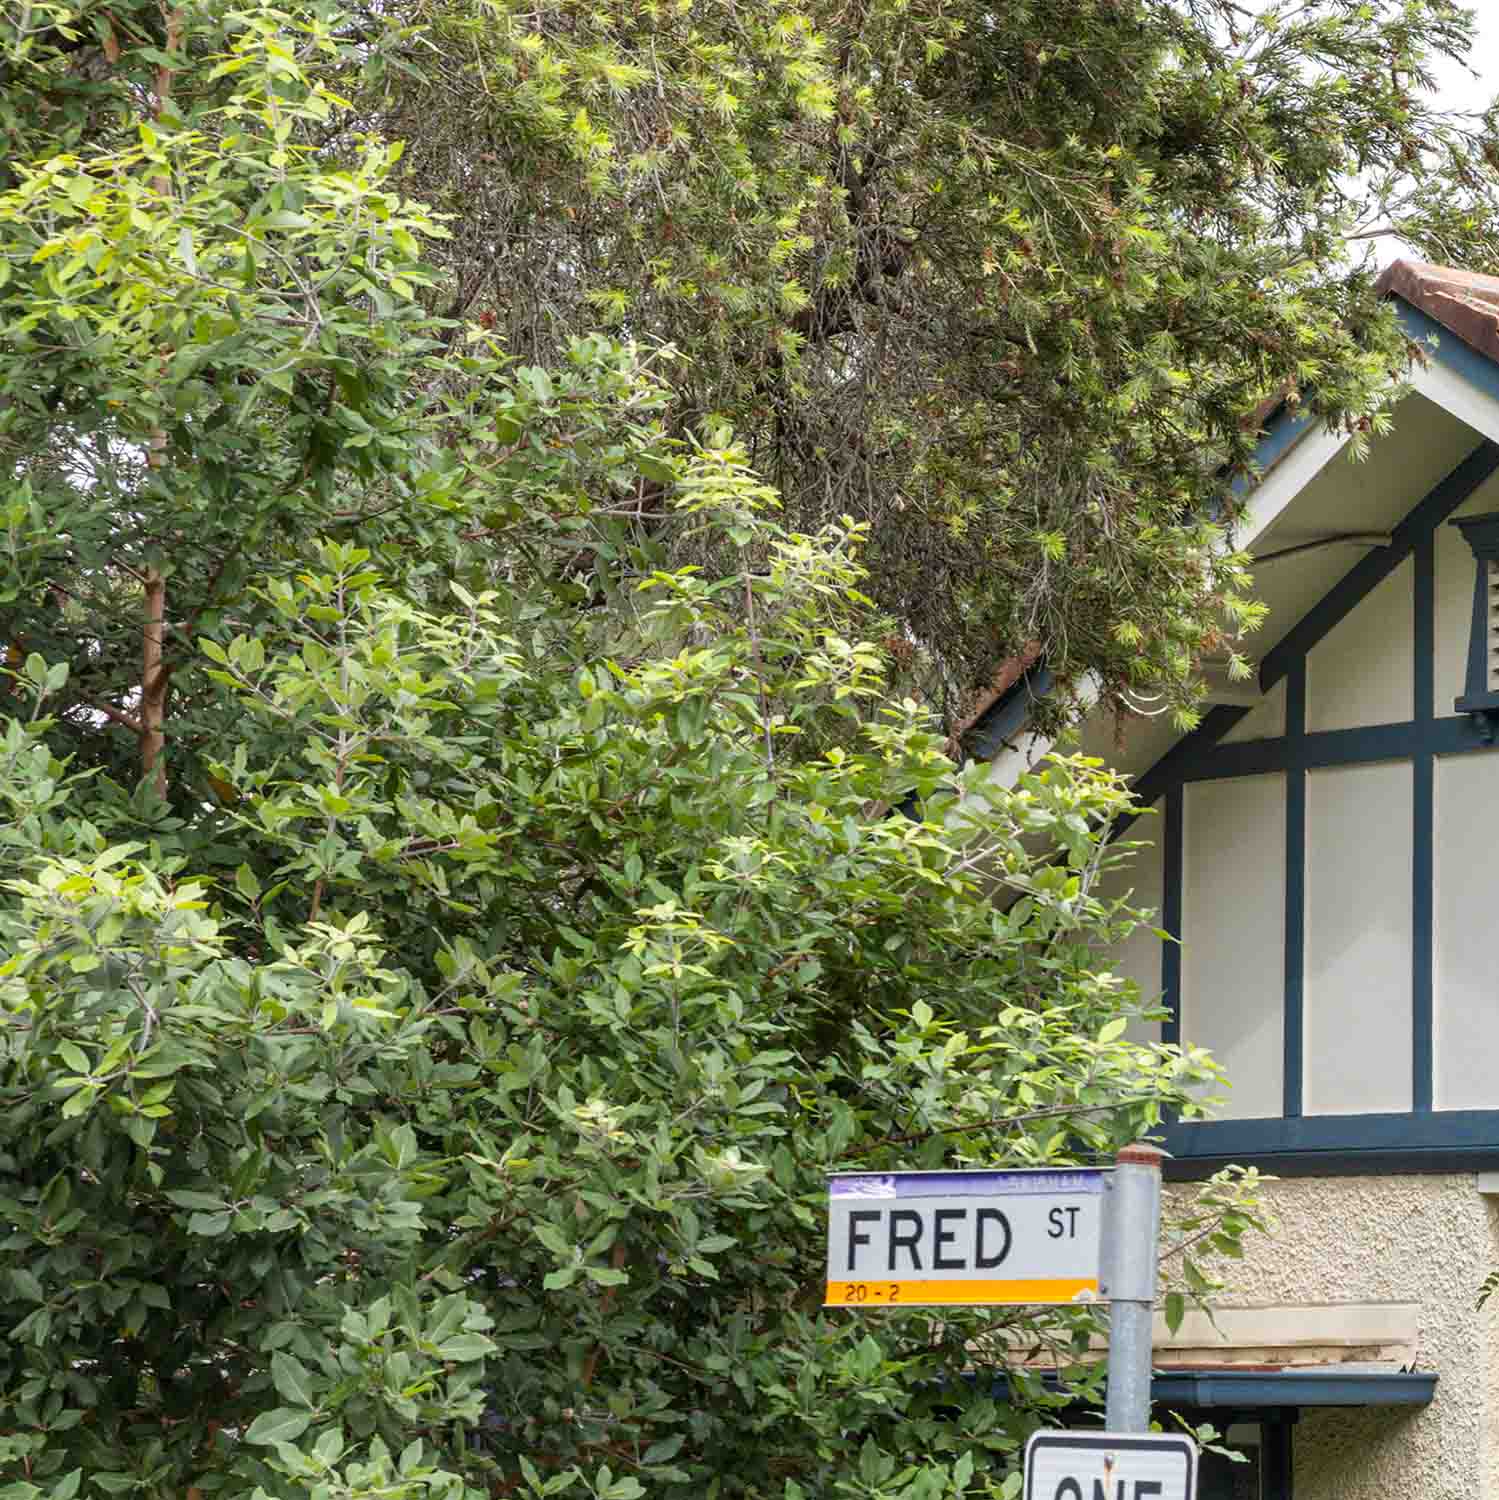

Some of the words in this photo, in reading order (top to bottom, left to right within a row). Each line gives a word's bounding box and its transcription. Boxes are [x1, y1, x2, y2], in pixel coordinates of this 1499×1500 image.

[847, 1207, 1012, 1271] FRED
[1047, 1206, 1080, 1239] ST
[845, 1285, 867, 1301] 20
[889, 1284, 899, 1301] 2
